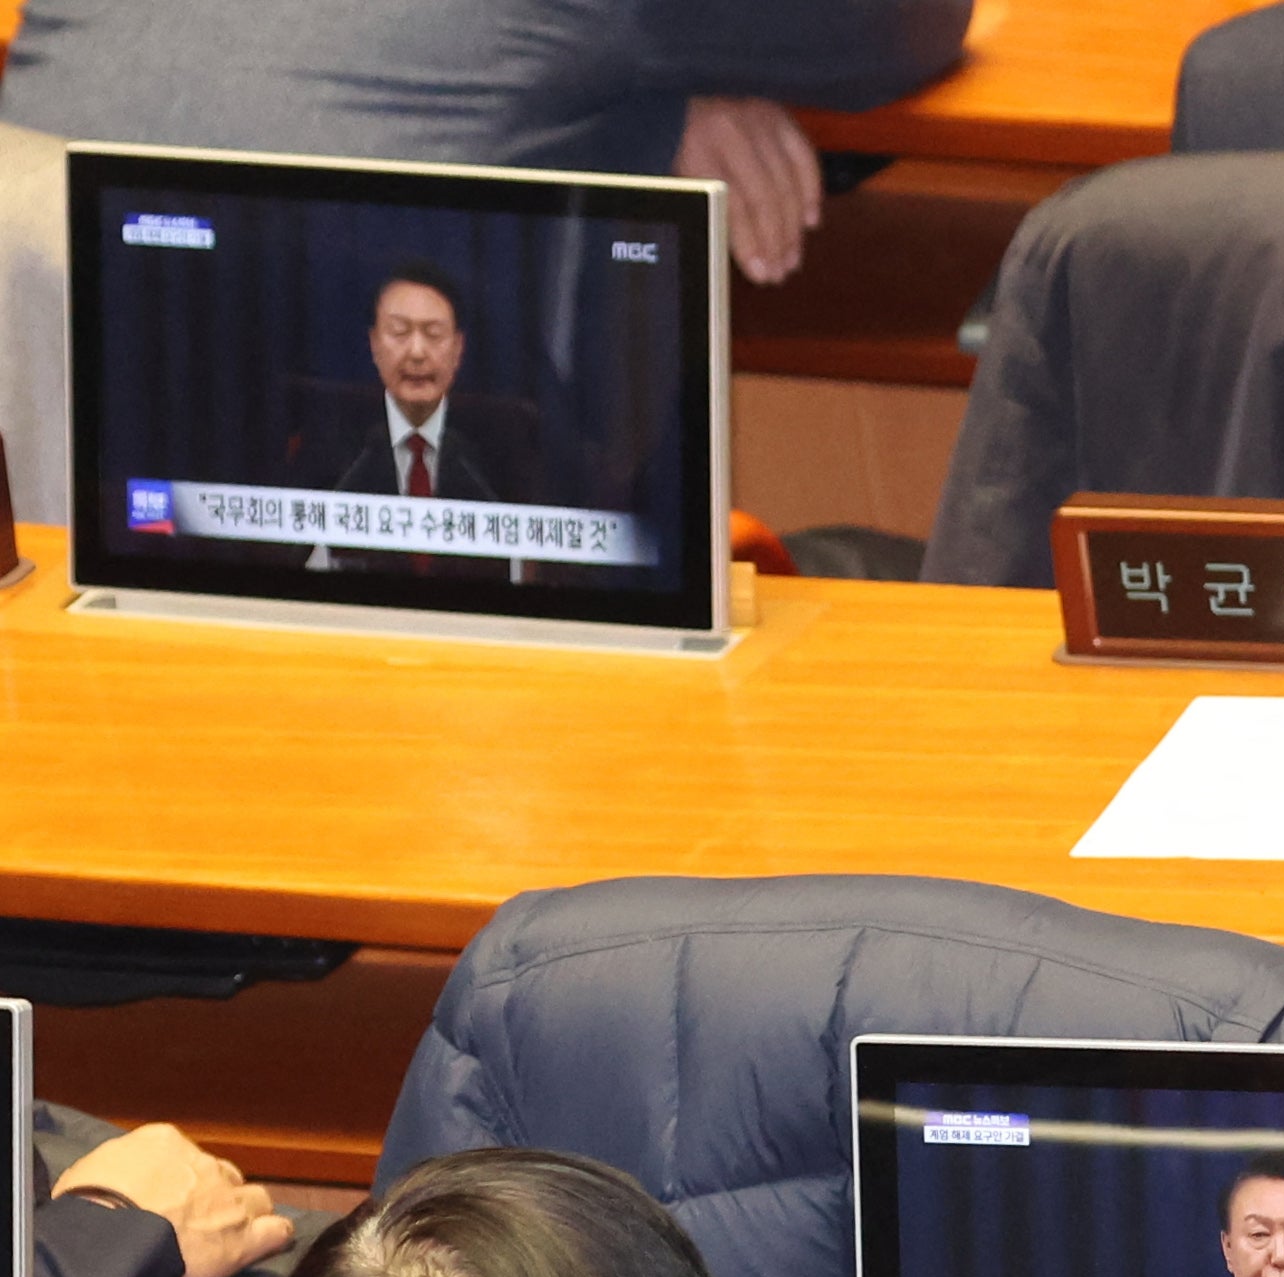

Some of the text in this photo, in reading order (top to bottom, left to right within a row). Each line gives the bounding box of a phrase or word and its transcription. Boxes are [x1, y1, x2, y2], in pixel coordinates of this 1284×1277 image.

[612, 240, 658, 263] MBC
[291, 501, 327, 531] 통해
[334, 503, 371, 535] 국회
[377, 507, 414, 537] 요구
[420, 511, 477, 541] 수용해
[483, 514, 520, 546] 계엄
[526, 518, 584, 550] 해제할
[590, 522, 620, 552] 것"
[943, 1114, 972, 1126] MBC
[930, 1130, 949, 1140] 계엄
[951, 1130, 971, 1141] 해제
[1005, 1131, 1025, 1143] 가결
